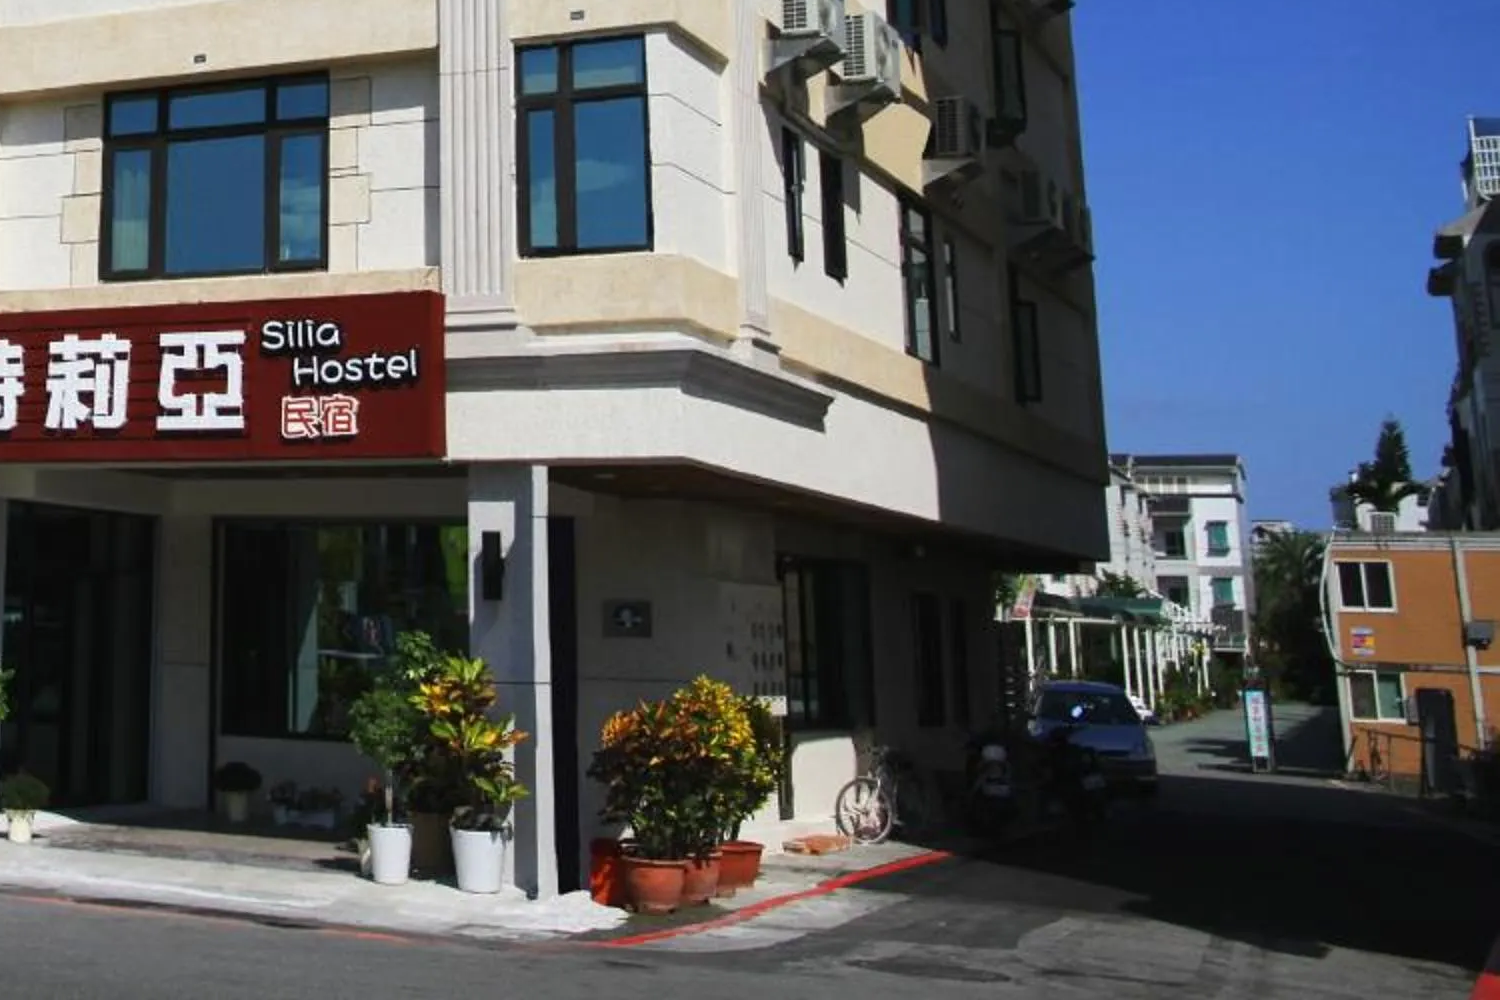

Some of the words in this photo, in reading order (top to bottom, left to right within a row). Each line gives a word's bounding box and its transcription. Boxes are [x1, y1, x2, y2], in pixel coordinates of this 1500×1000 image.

[261, 319, 341, 353] Silia
[293, 349, 418, 387] Hostel
[281, 394, 360, 439] 民宿
